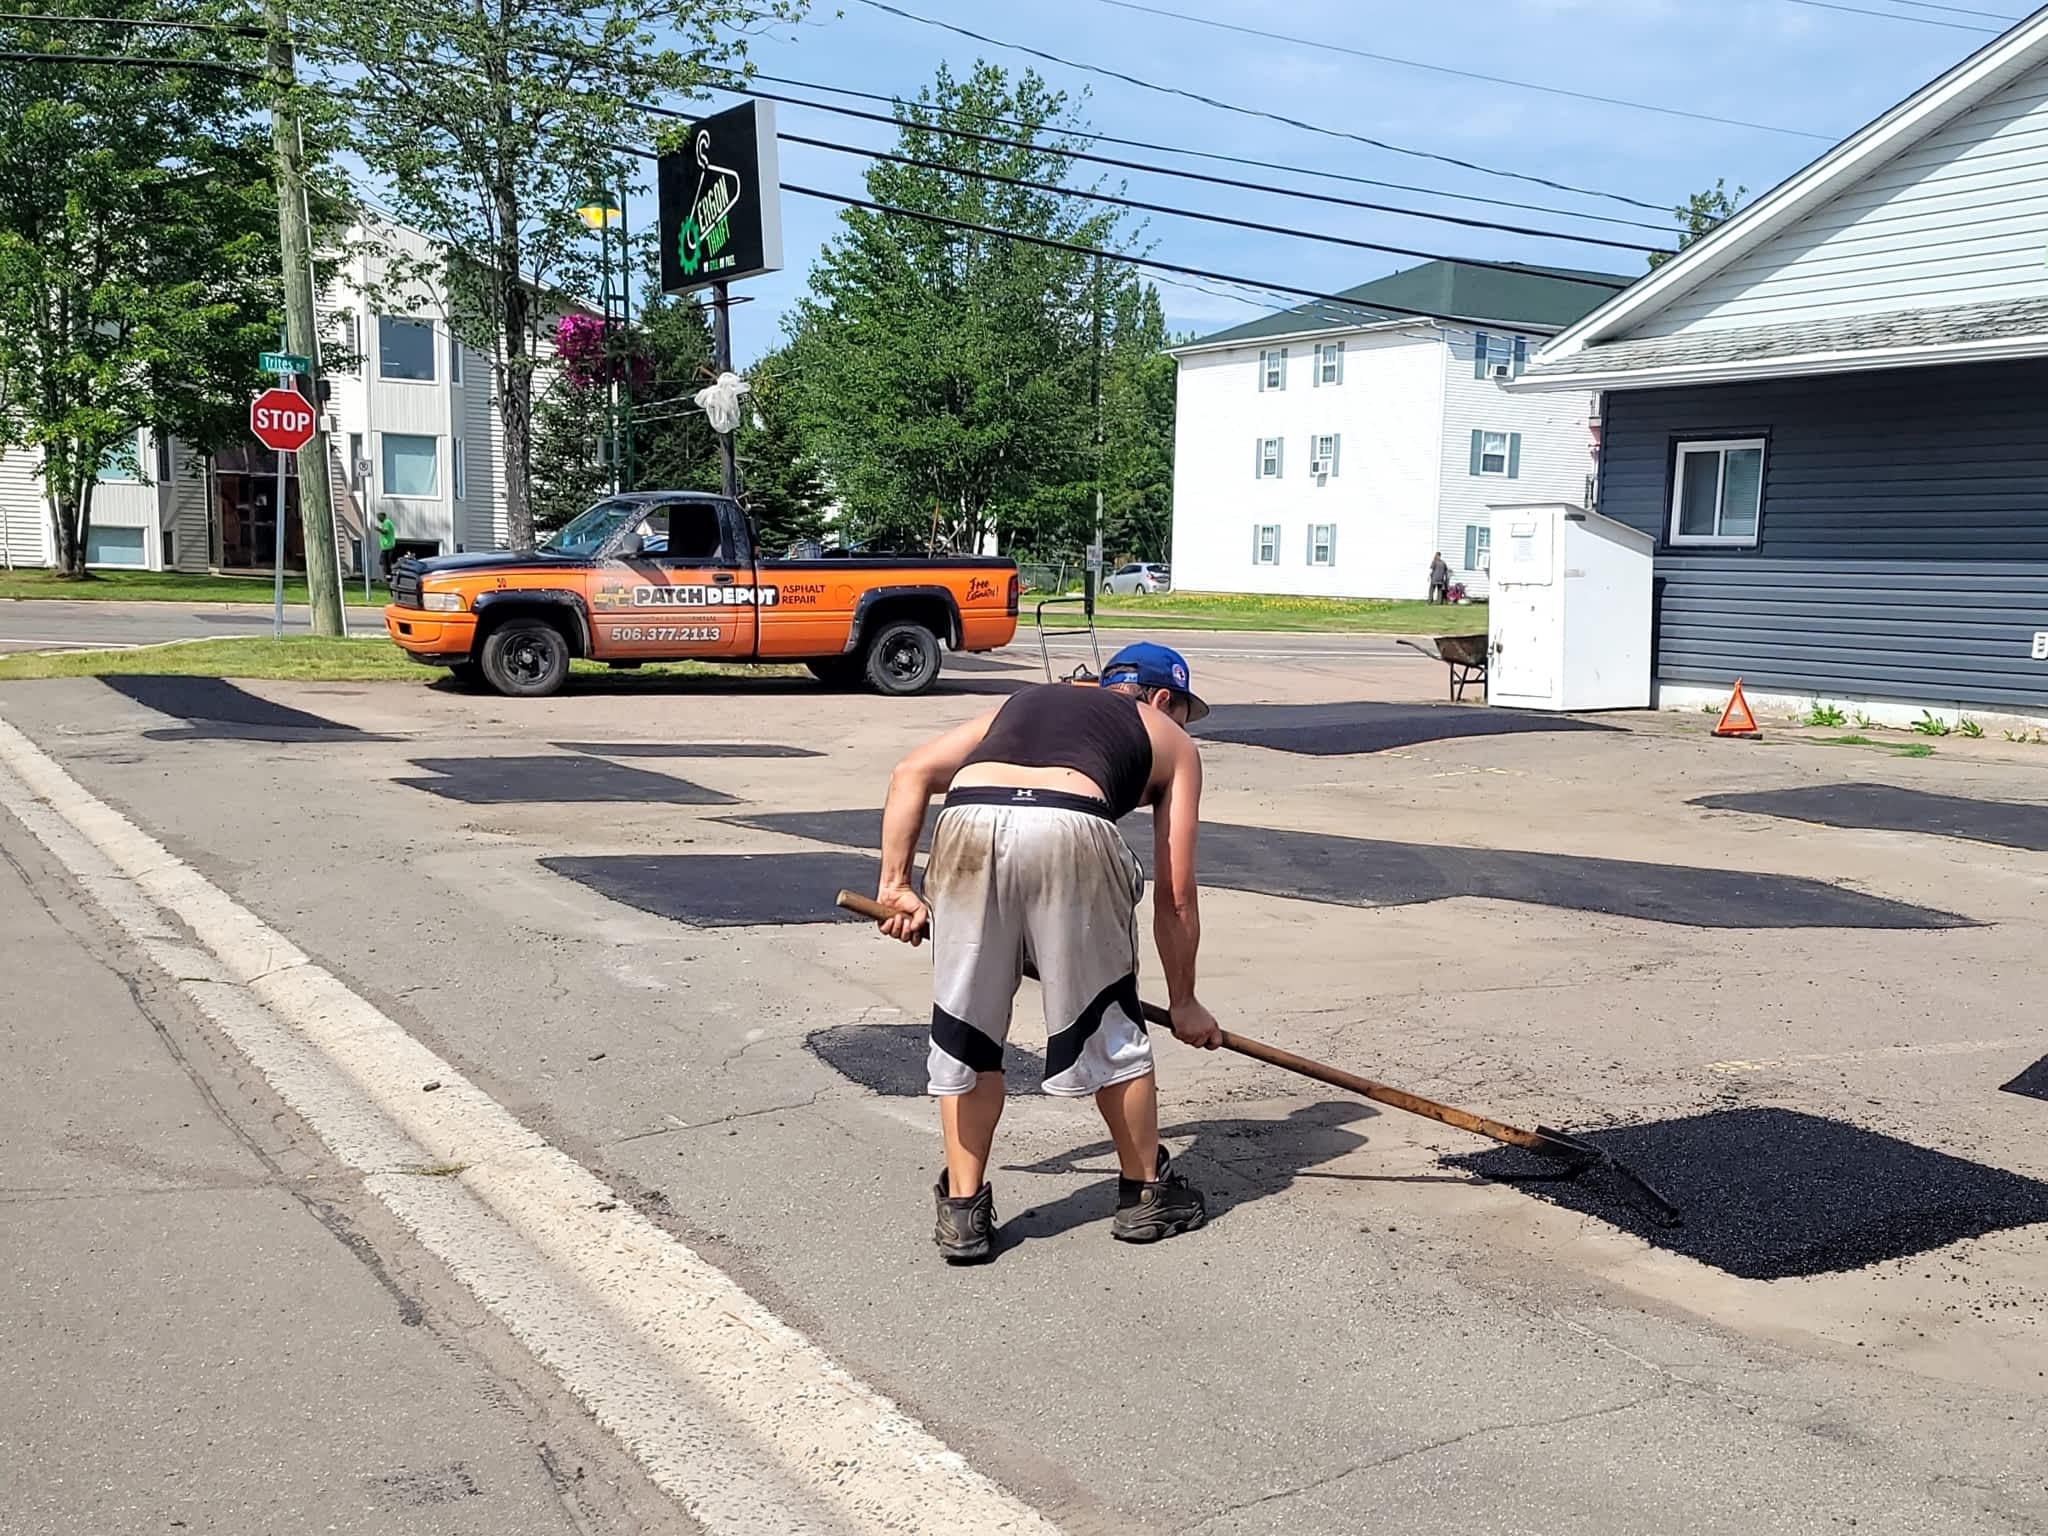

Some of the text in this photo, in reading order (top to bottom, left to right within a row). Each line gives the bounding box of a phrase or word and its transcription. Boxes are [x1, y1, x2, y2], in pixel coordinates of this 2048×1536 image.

[697, 175, 729, 233] ERGON
[706, 215, 731, 258] THRIFT
[265, 357, 293, 370] Trites
[257, 408, 310, 432] STOP
[782, 584, 826, 593] ASPHALT
[637, 588, 775, 605] PATCH DEPOT
[782, 595, 816, 604] REPAIR
[611, 628, 720, 640] 506.377.2113
